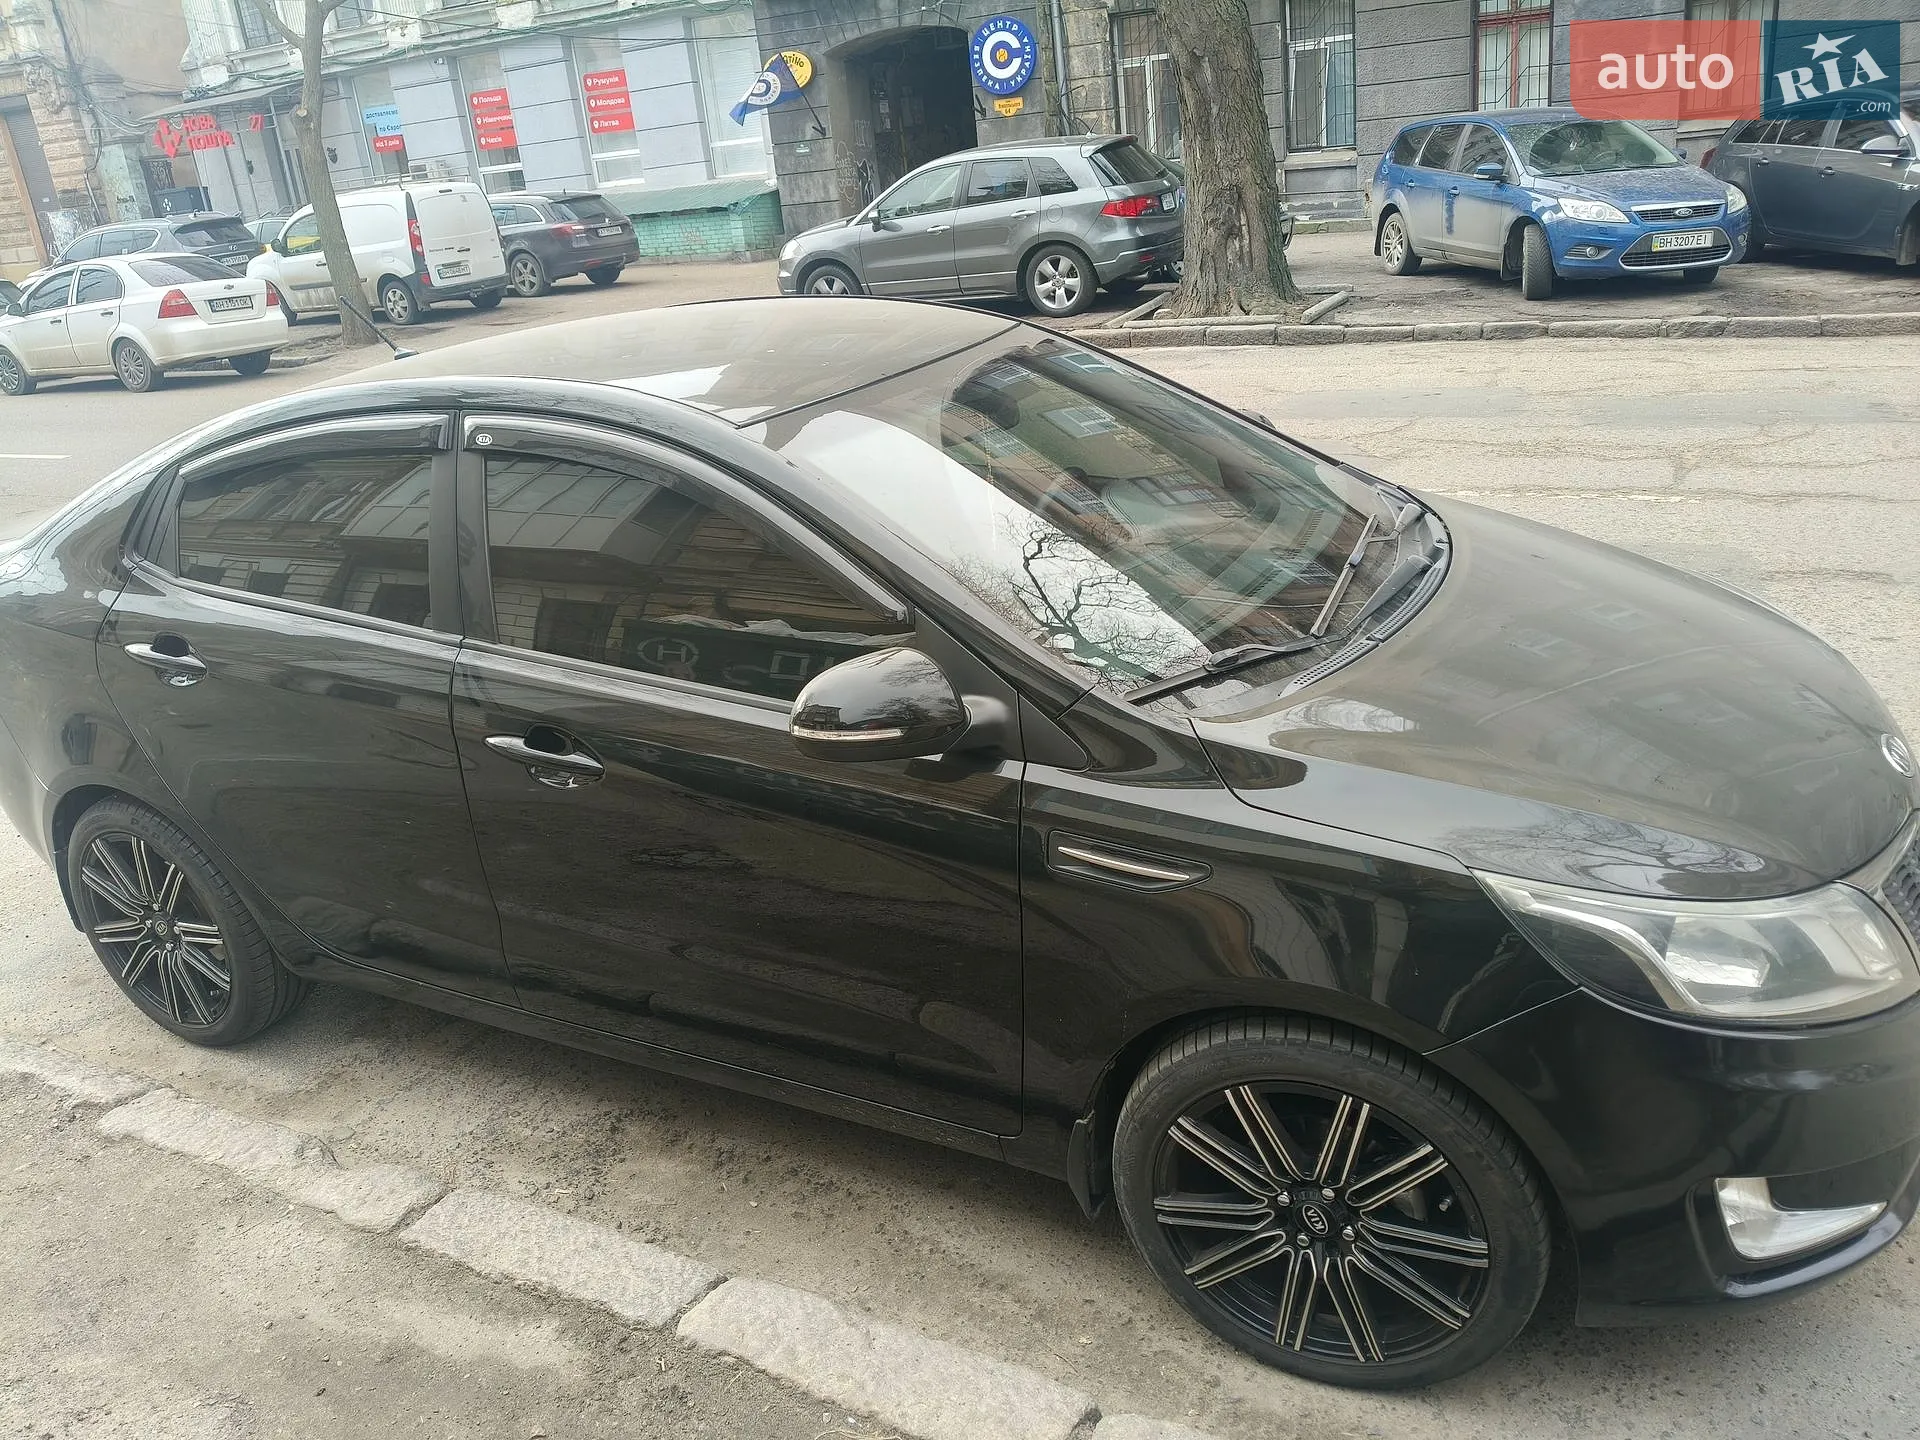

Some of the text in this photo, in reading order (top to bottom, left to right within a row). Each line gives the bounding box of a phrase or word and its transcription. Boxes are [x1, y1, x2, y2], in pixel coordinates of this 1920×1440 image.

[981, 20, 1019, 37] ЦЕНТР
[593, 76, 619, 86] Румунія
[478, 95, 502, 104] Польща
[596, 97, 625, 106] Молдова
[182, 114, 217, 132] НОВА
[600, 119, 620, 128] Литва
[187, 130, 236, 151] ПОШТА
[1307, 1209, 1325, 1230] KIA
